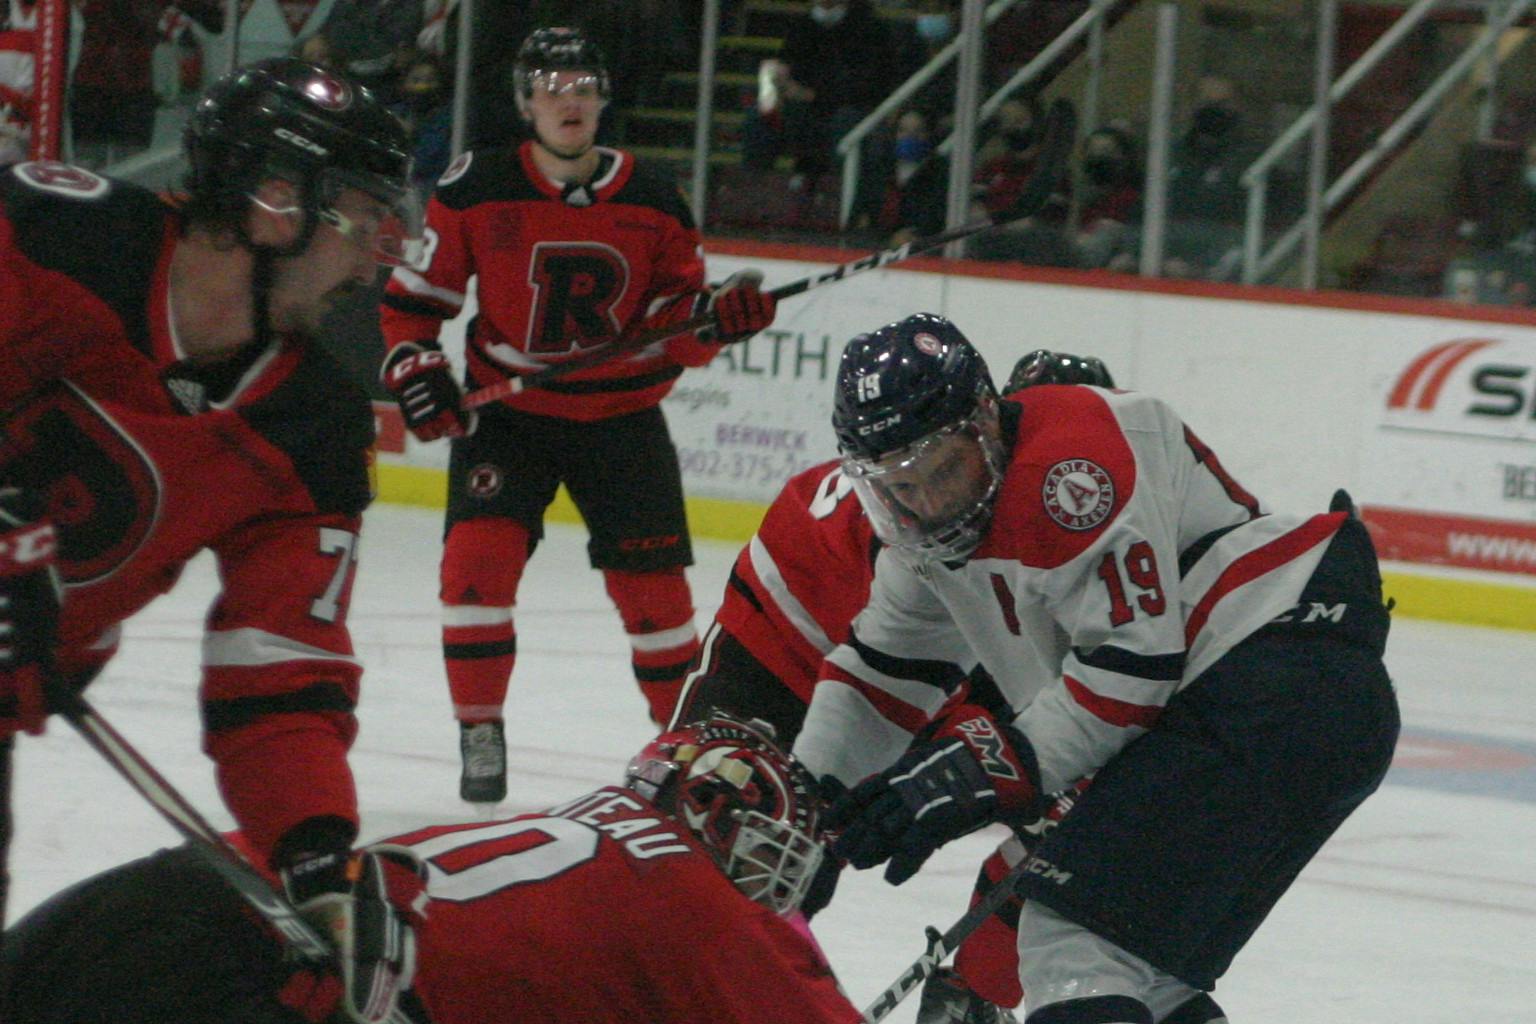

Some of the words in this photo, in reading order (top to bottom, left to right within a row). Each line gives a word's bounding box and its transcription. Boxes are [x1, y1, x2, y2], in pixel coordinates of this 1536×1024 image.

[527, 241, 631, 355] R
[708, 329, 829, 380] ALTH
[858, 372, 881, 402] 19
[714, 422, 807, 449] BERWICK
[858, 414, 901, 437] CCM
[310, 526, 359, 623] 7
[1098, 541, 1167, 629] 19
